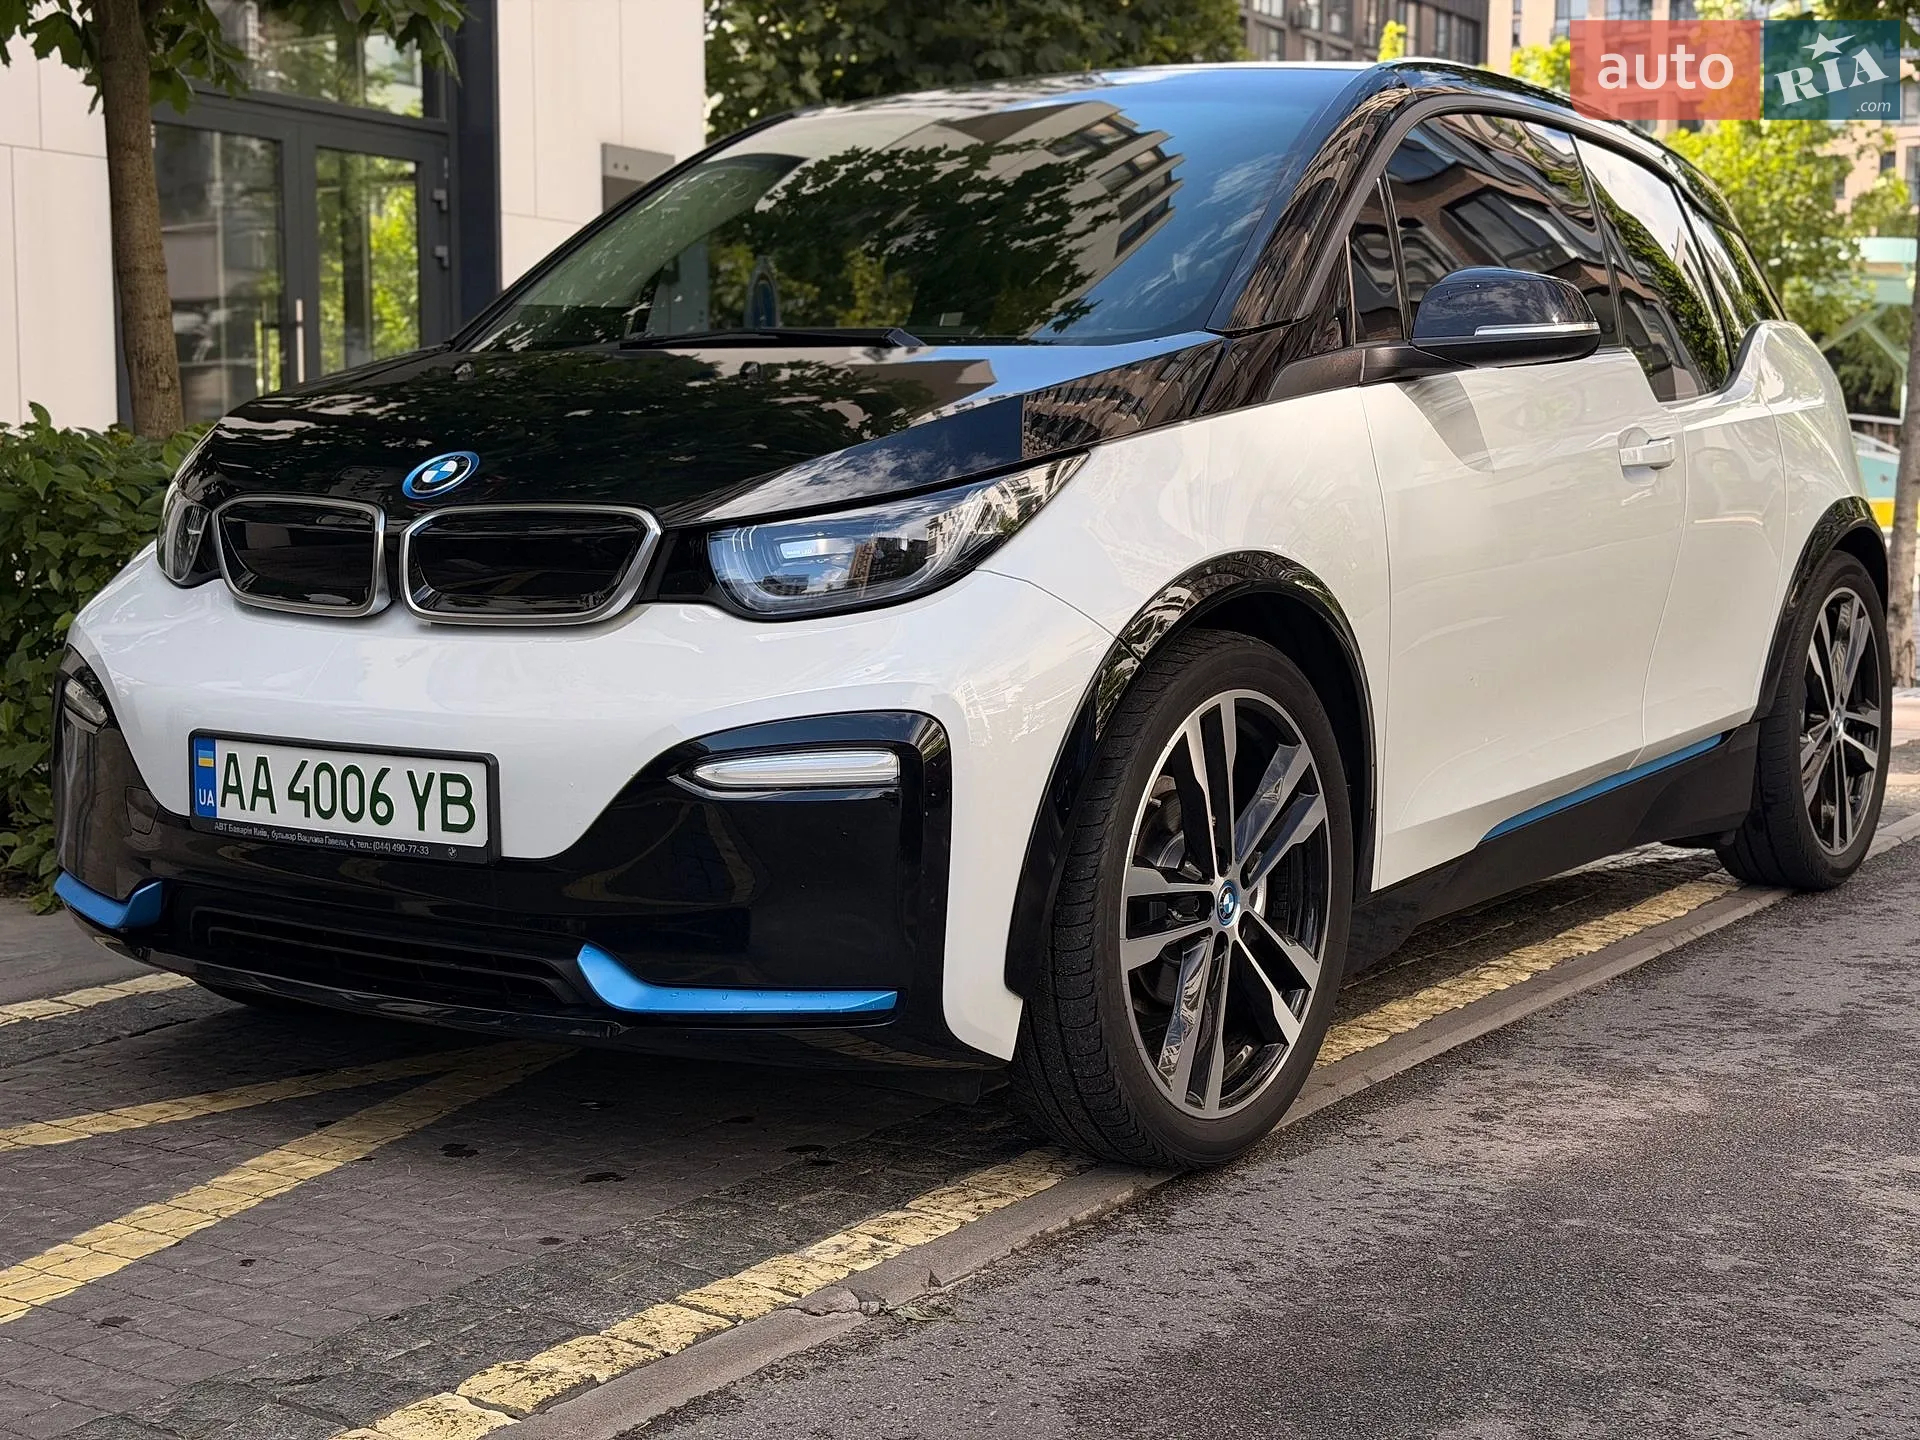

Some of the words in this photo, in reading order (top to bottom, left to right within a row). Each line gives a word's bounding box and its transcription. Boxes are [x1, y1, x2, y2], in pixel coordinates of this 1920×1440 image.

[198, 788, 215, 807] UA
[220, 752, 277, 815] AA
[287, 759, 395, 826] 4006
[406, 769, 476, 833] YB
[392, 843, 429, 855] 490-77-33
